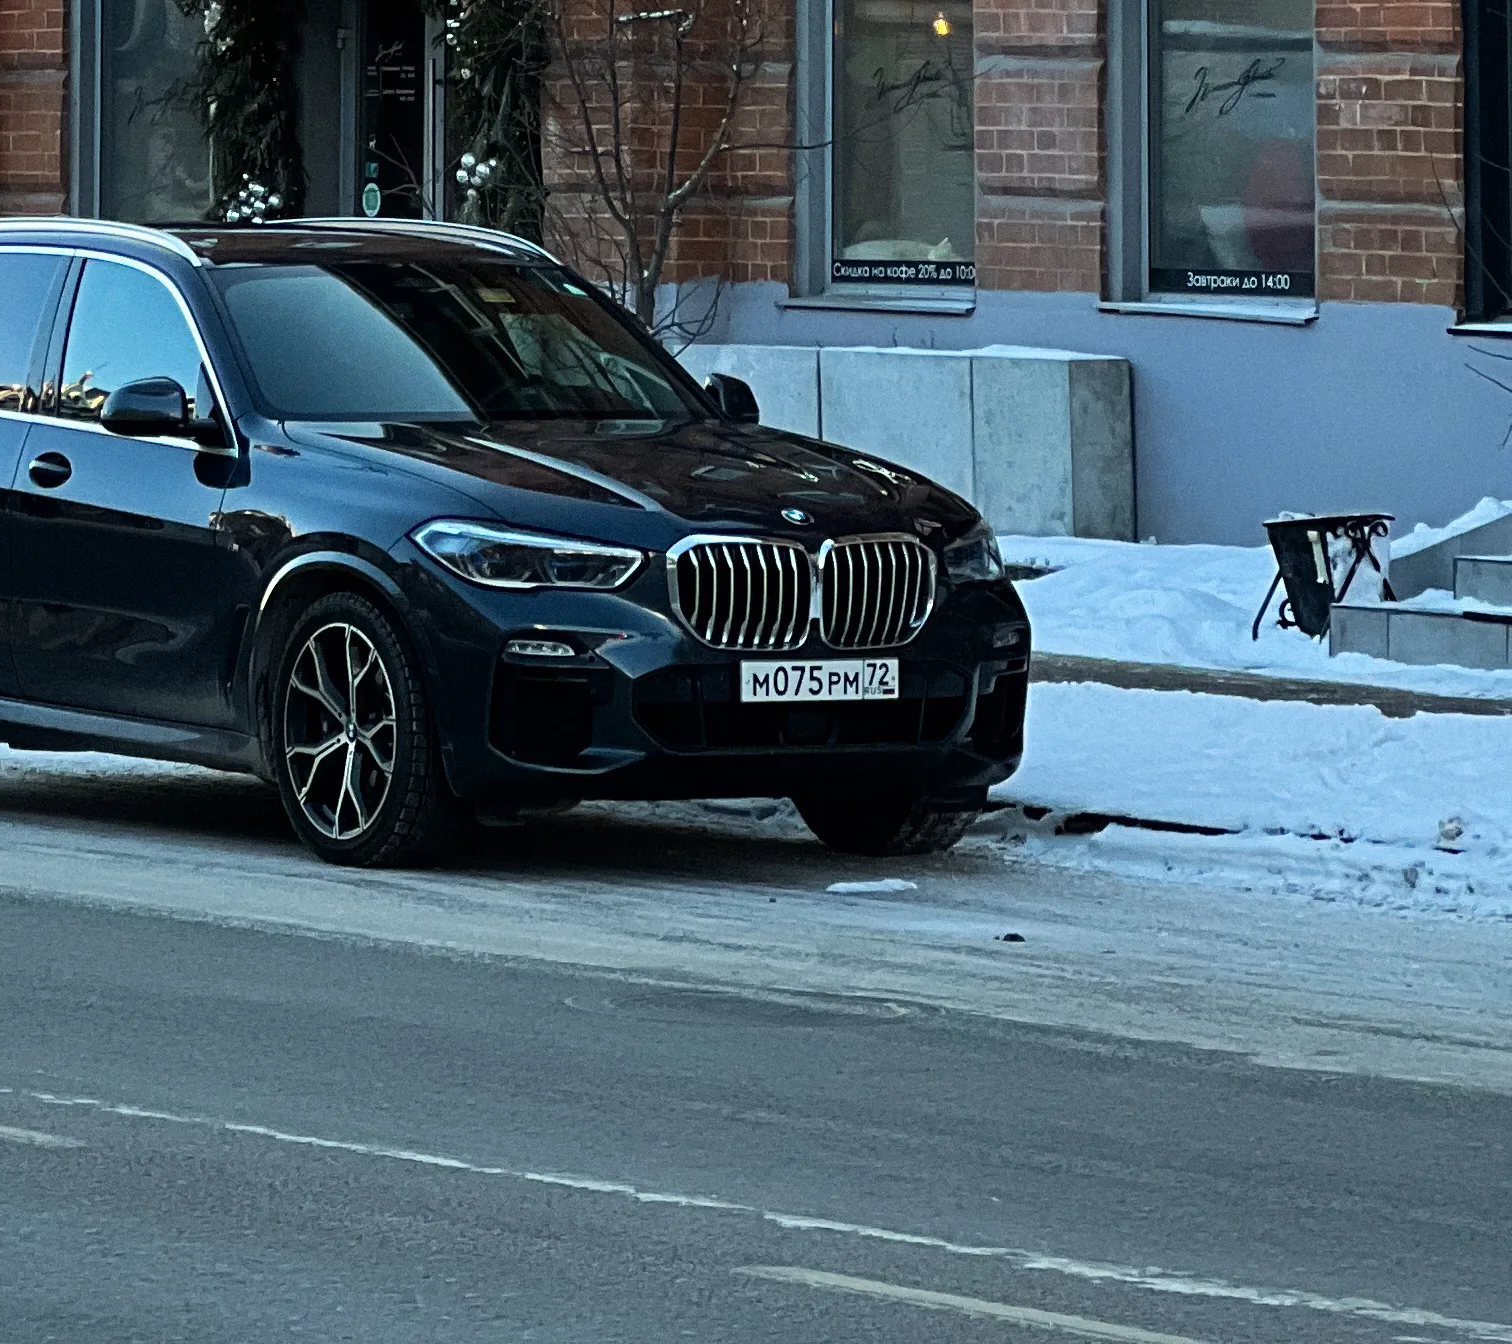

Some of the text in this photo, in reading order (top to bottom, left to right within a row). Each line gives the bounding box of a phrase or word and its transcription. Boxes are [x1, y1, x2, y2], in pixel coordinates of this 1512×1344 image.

[833, 262, 976, 280] Скидка на кофе 20% до 10:0
[1187, 272, 1291, 290] Завтраки до 14:00
[866, 663, 890, 687] 72
